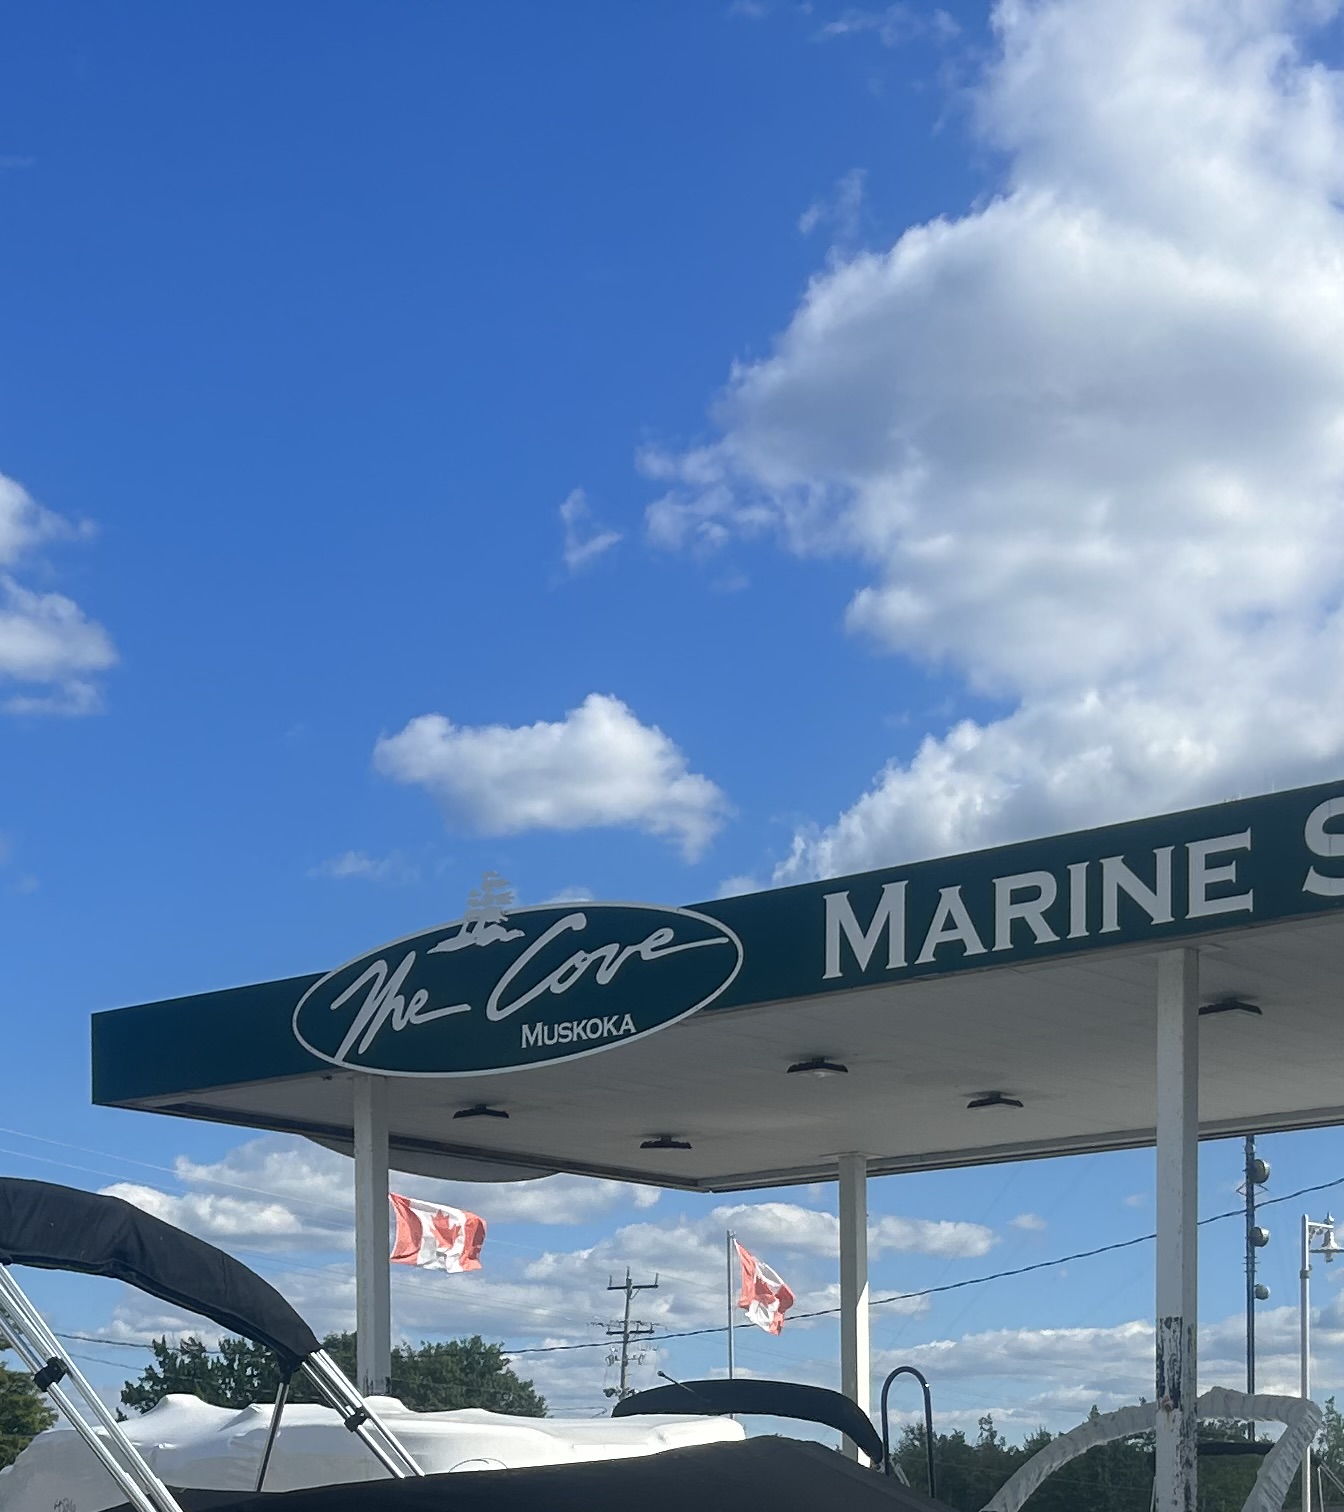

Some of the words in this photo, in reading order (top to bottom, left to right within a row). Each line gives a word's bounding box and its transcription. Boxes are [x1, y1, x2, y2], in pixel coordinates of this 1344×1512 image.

[822, 827, 1254, 980] MARINE
[331, 950, 472, 1063] The
[486, 913, 729, 1021] Cove
[521, 1013, 637, 1048] MUSKOKA
